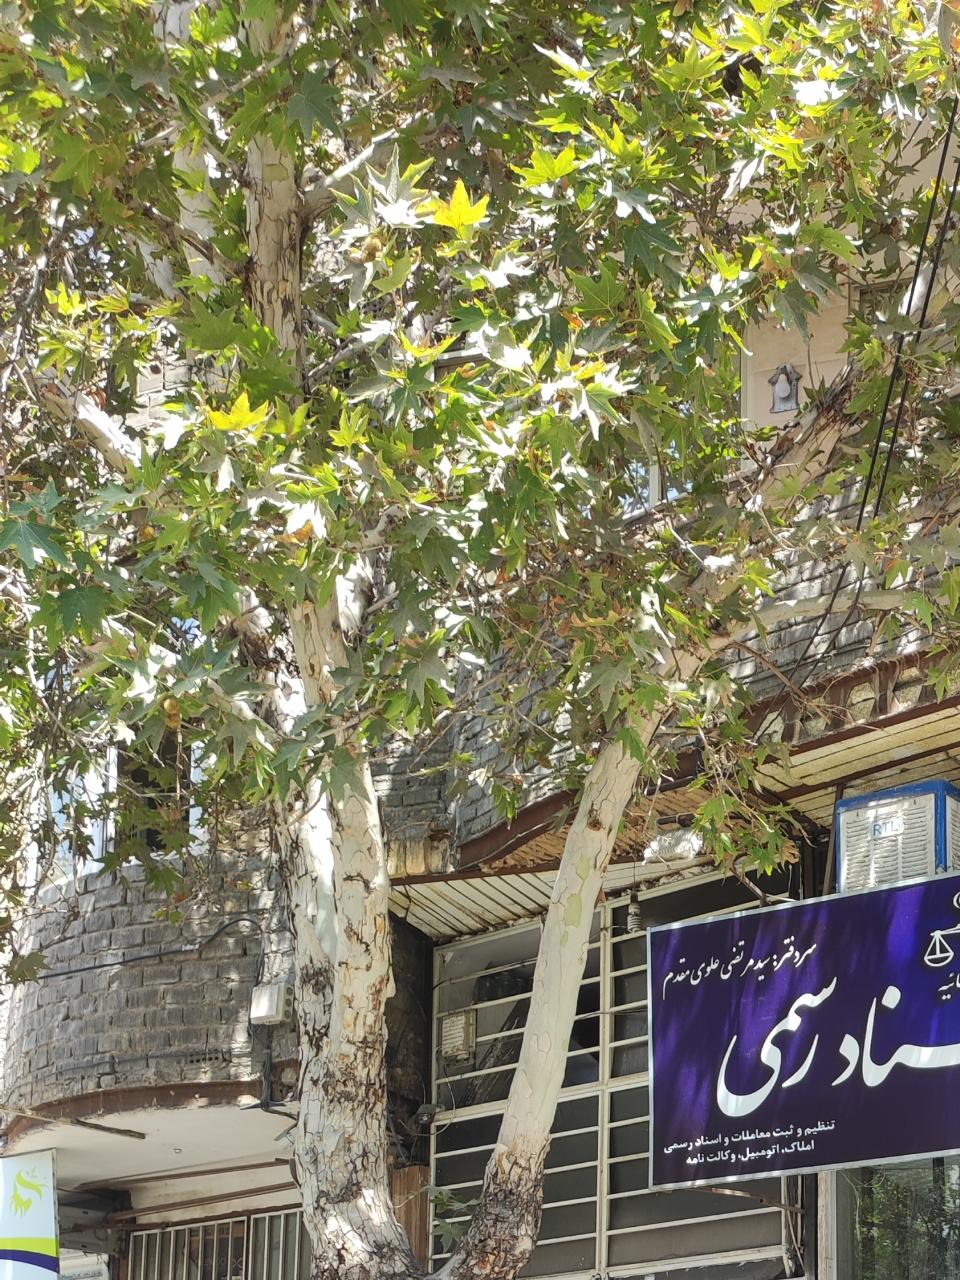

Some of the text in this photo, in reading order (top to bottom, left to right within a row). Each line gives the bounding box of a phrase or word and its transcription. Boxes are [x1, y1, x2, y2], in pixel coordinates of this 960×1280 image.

[662, 957, 691, 1001] مقدم
[690, 955, 720, 985] علوی
[716, 976, 838, 1118] رسمی
[663, 1120, 836, 1154] تنظیم و ثبت معاملات و اسناد رسمی
[686, 1153, 705, 1165] نامه
[706, 1149, 737, 1163] وکالت
